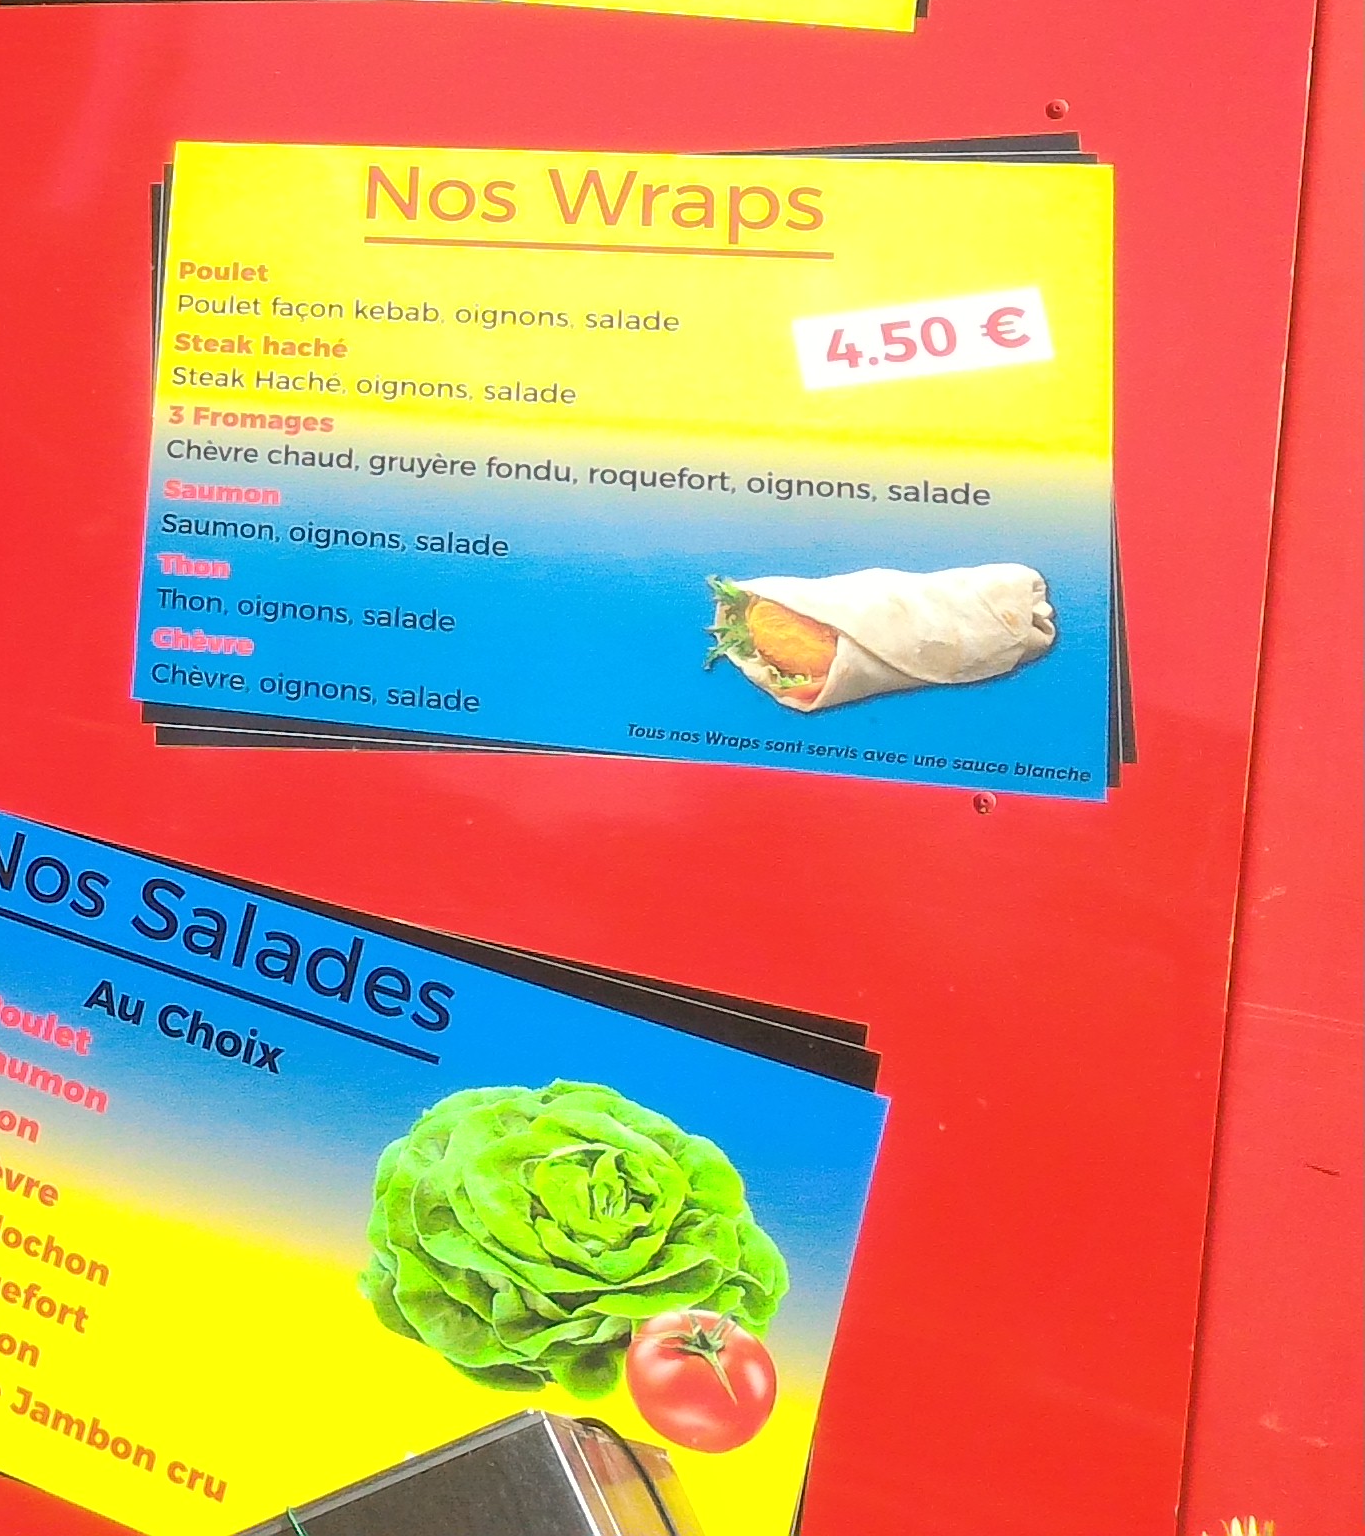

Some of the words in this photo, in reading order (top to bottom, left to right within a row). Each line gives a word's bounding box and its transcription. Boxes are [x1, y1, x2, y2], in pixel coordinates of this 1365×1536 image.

[366, 165, 518, 224] Nos
[548, 167, 826, 246] Wraps
[178, 260, 270, 284] Poulet
[177, 293, 262, 319] Poulet
[270, 296, 344, 324] façon
[455, 304, 576, 331] oignons,
[585, 308, 681, 333] salade
[173, 332, 254, 356] Steak
[262, 334, 350, 360] haché
[826, 315, 958, 370] 4.50
[980, 305, 1032, 349] €
[171, 365, 245, 390] Steak
[255, 368, 348, 396] Haché,
[356, 374, 475, 402] oignons,
[483, 380, 578, 406] salade
[168, 404, 186, 426] 3
[192, 405, 336, 438] Fromages
[162, 478, 282, 507] Saumon
[166, 437, 259, 465] Chèvre
[267, 442, 362, 473] chaud,
[368, 451, 478, 480] gruyère
[485, 454, 579, 486] fondu,
[588, 464, 737, 495] roquefort,
[746, 471, 879, 504] oignons,
[886, 479, 992, 508] salade
[160, 512, 282, 543] Saumon,
[288, 520, 408, 553] oignons,
[414, 530, 510, 558] salade
[156, 551, 232, 580] Thon
[156, 587, 229, 616] Thon,
[236, 594, 355, 627] oignons,
[361, 605, 457, 634] salade
[151, 626, 256, 657] Chèvre
[150, 662, 252, 694] Chèvre,
[258, 672, 379, 706] oignons,
[385, 684, 481, 714] salade
[625, 721, 667, 741] Tous
[669, 729, 701, 746] nos
[704, 730, 761, 753] Wraps
[765, 737, 806, 755] sont
[807, 743, 858, 761] servis
[862, 748, 909, 766] avec
[913, 754, 948, 770] une
[952, 757, 1009, 776] sauce
[1014, 760, 1093, 784] blanche
[129, 876, 456, 1034] Salades
[82, 977, 146, 1026] Au
[156, 1003, 287, 1076] Choix
[9, 1385, 157, 1473] Jambon
[166, 1458, 229, 1504] cru
